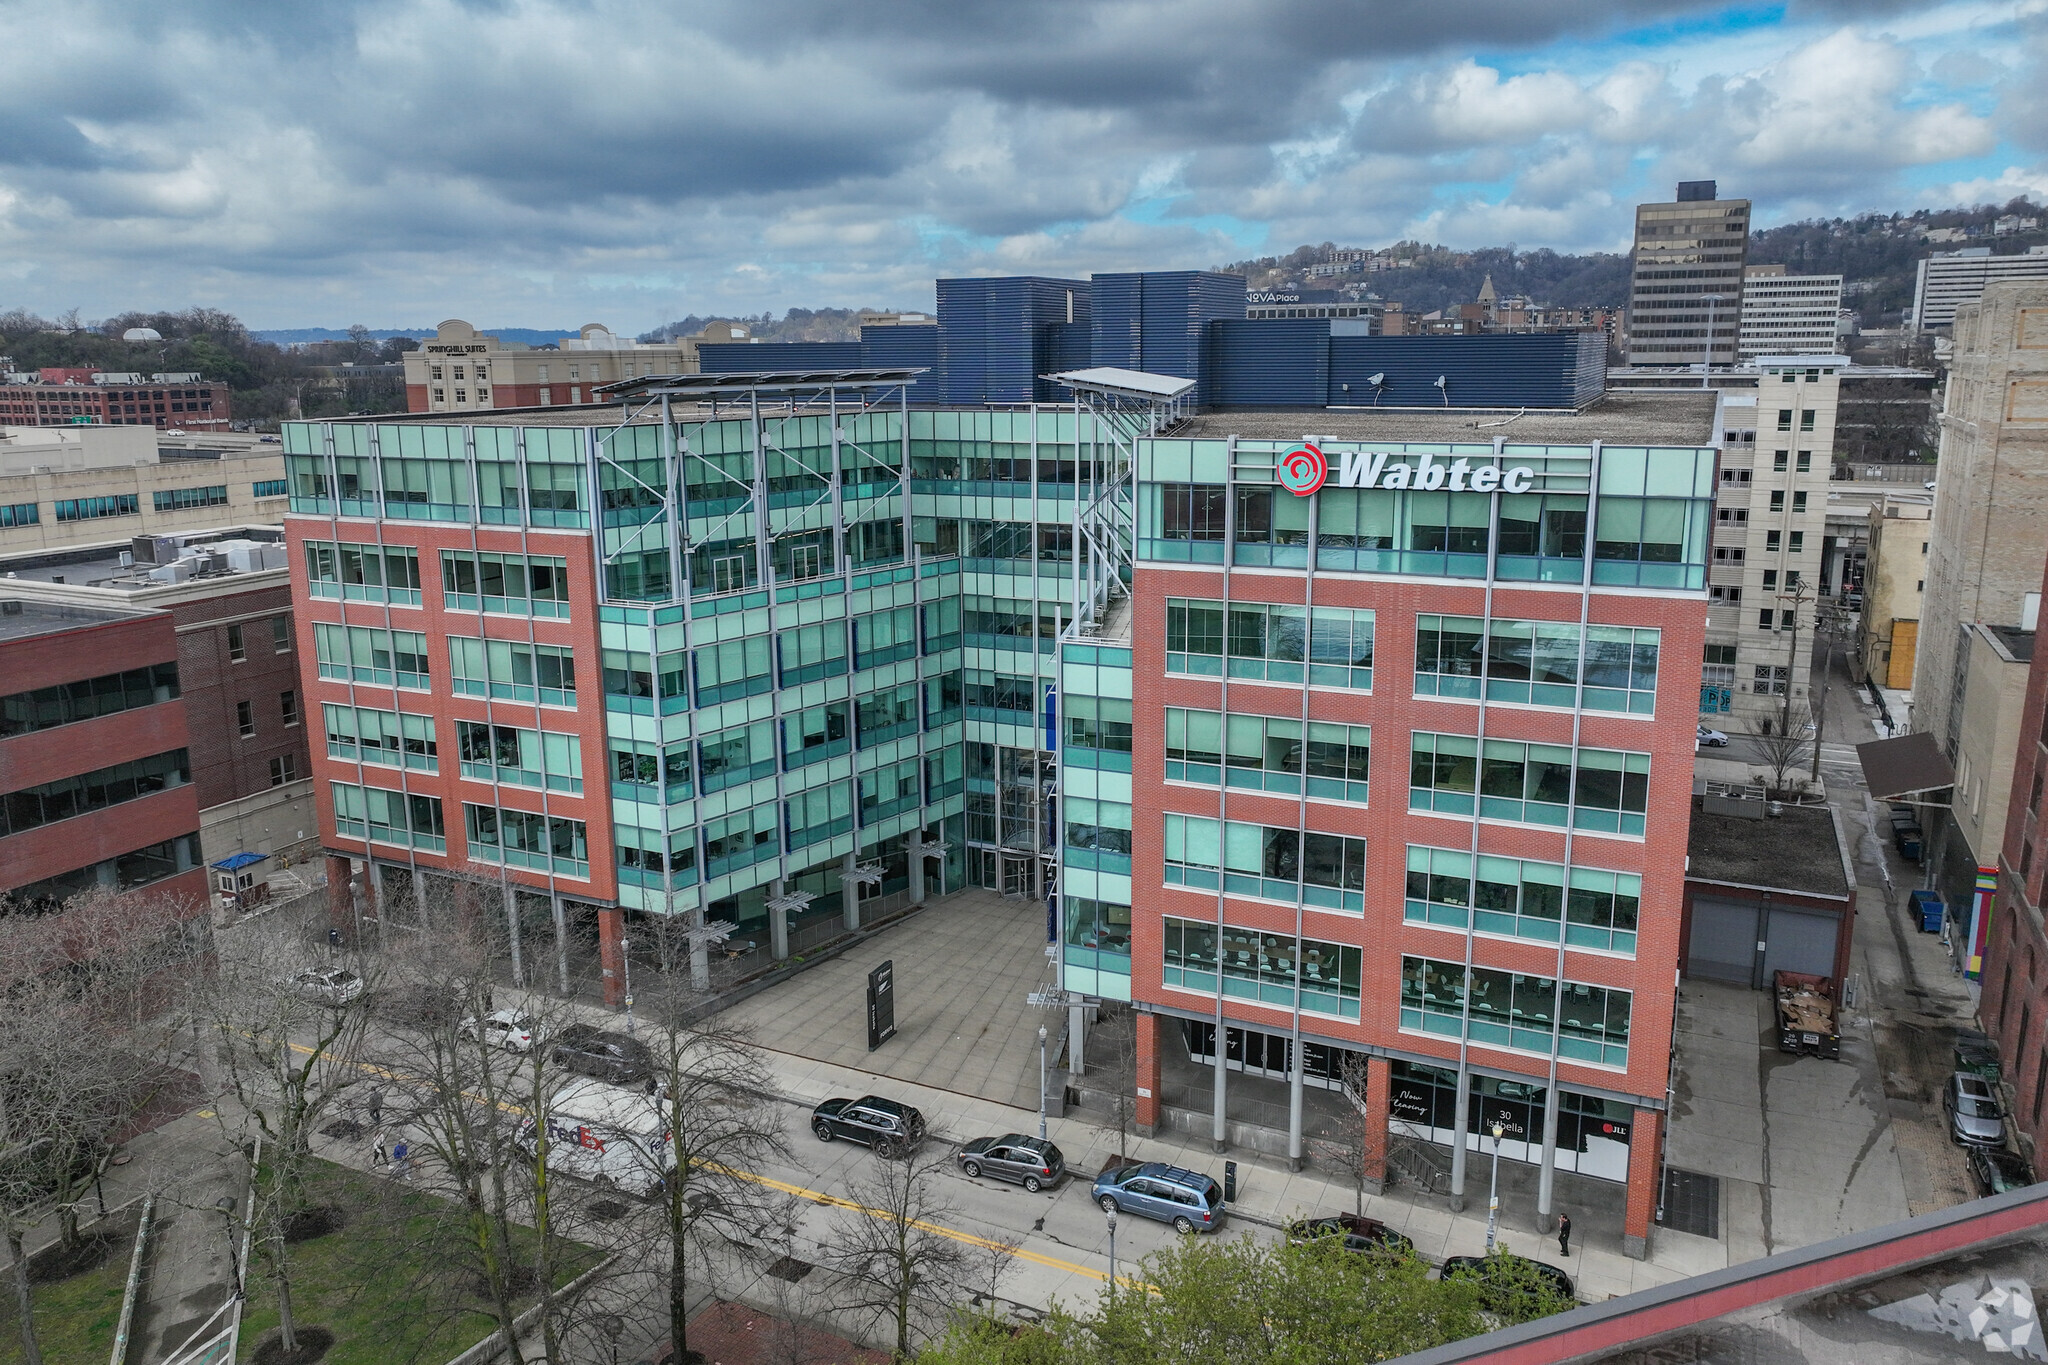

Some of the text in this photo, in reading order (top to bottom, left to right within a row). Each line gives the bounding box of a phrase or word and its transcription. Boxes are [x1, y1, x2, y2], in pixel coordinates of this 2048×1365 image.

[1276, 294, 1300, 302] Place
[427, 345, 487, 353] SPRINGHILL SUITES
[1339, 451, 1534, 494] Wabtec
[1400, 1090, 1423, 1101] Now
[1500, 1110, 1512, 1120] 30
[548, 1117, 606, 1154] FedEx
[1612, 1126, 1627, 1135] JLL
